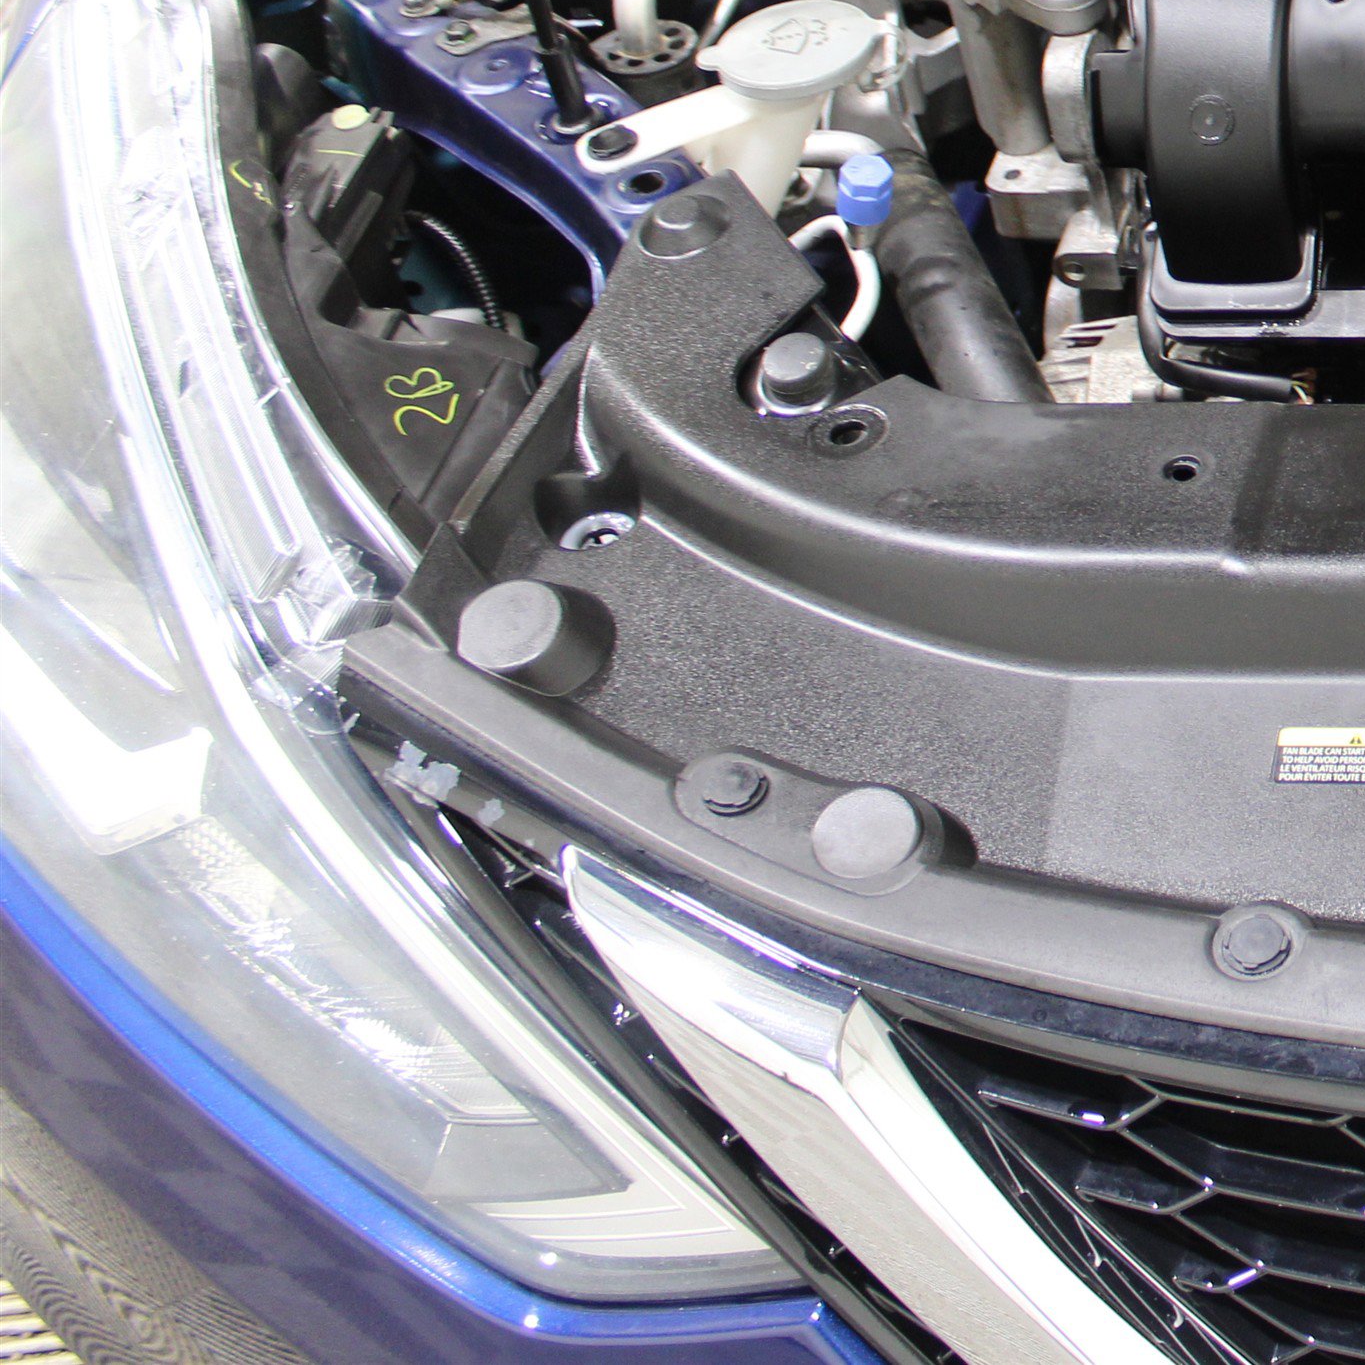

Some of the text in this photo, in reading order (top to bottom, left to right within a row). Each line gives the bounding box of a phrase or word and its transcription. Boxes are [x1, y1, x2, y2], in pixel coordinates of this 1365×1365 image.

[1282, 746, 1299, 755] FAN
[1299, 746, 1323, 755] BLADE
[1324, 746, 1342, 755] CAN
[1342, 746, 1365, 755] START
[1282, 756, 1294, 765] TO
[1294, 756, 1314, 765] HELP
[1314, 756, 1339, 765] AVOID
[1280, 764, 1290, 774] LE
[1290, 764, 1346, 774] VENTILATEUR
[1278, 773, 1303, 782] POUR
[1303, 773, 1333, 782] ÉVITER
[1333, 773, 1360, 782] TOUTE
